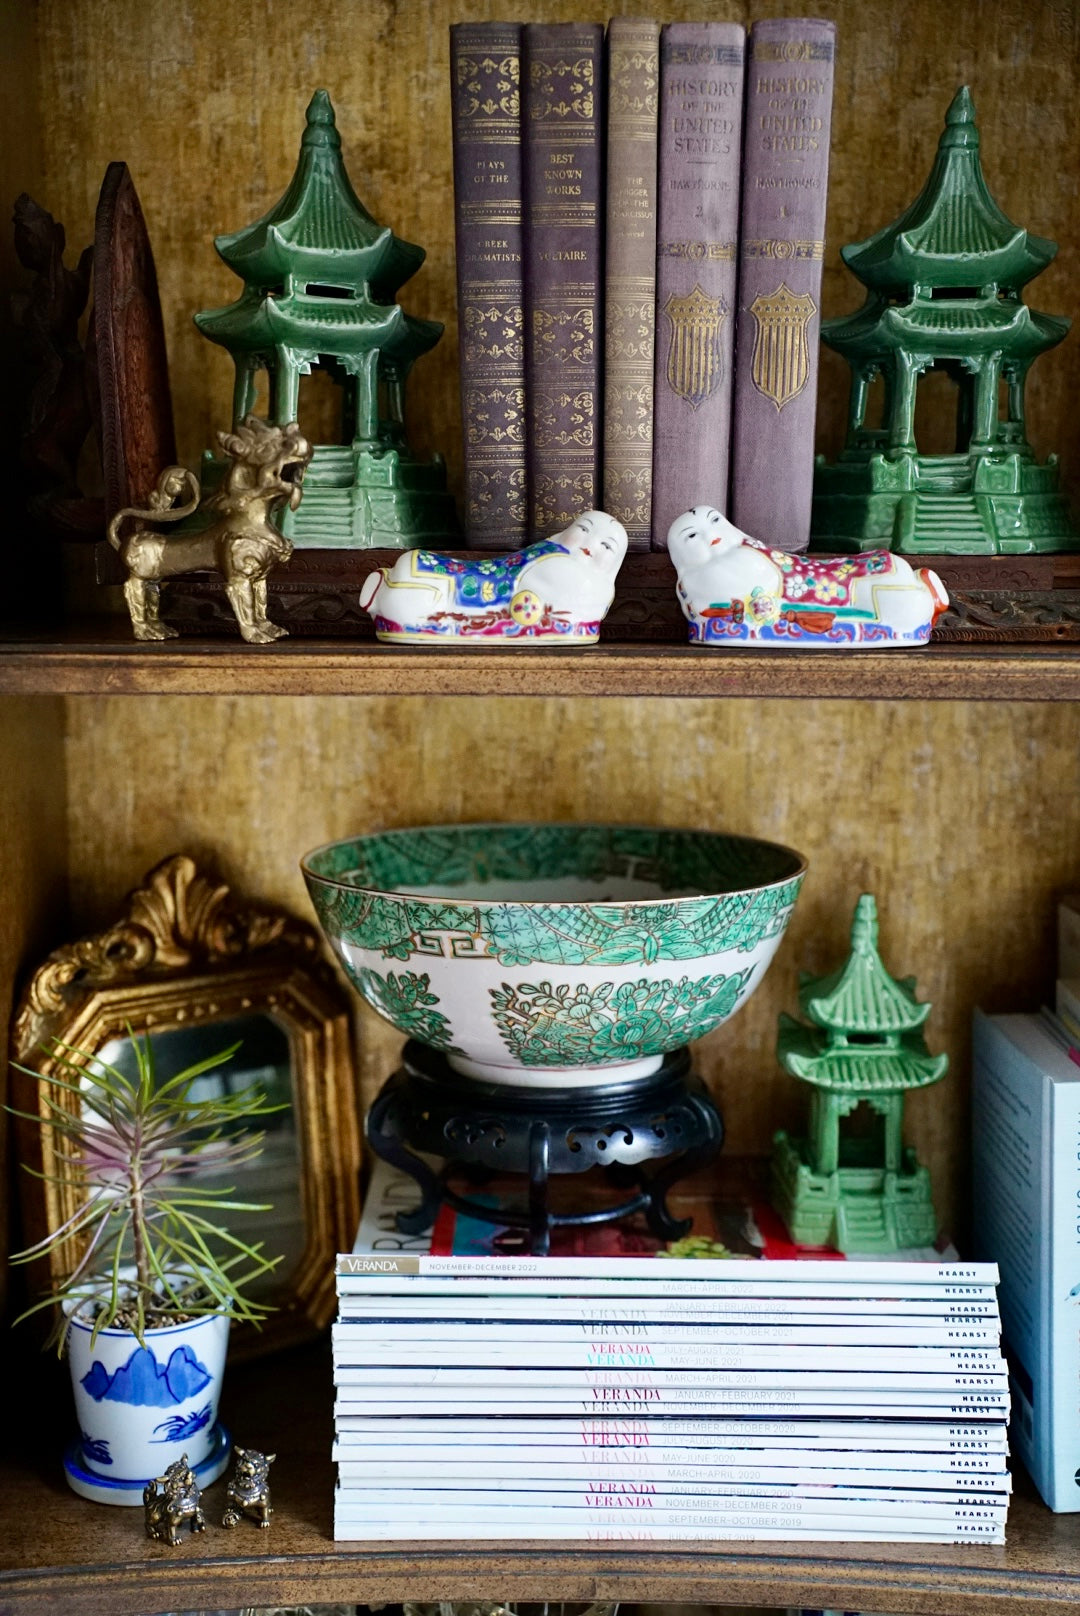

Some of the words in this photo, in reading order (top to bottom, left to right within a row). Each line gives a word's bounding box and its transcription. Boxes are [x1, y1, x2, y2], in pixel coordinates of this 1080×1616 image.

[670, 79, 737, 97] HISTORY
[756, 78, 827, 95] HISTORY
[682, 101, 698, 112] OF
[703, 101, 725, 112] THE
[768, 98, 786, 110] OF
[673, 118, 733, 134] UNITED
[760, 116, 822, 132] UNITED
[674, 138, 730, 154] STATES
[760, 136, 819, 152] STATES
[550, 154, 575, 164] BEST
[489, 175, 509, 183] THE
[544, 169, 582, 179] KNOWN
[546, 185, 581, 195] WORKS
[669, 179, 731, 191] HAWTHORNE
[634, 200, 649, 208] THE
[695, 205, 703, 218] 2
[347, 1259, 398, 1272] VERANDA
[582, 1325, 649, 1336] VERANDA
[591, 1344, 651, 1354] VERANDA
[587, 1354, 655, 1365] VERANDA
[584, 1372, 653, 1384] VERANDA
[592, 1388, 661, 1400] VERANDA
[581, 1402, 650, 1412] VERANDA
[581, 1420, 649, 1432] VERANDA
[582, 1434, 650, 1445] VERANDA
[582, 1451, 649, 1463] VERANDA
[589, 1482, 657, 1492] VERANDA
[585, 1495, 653, 1507] VERANDA
[780, 1502, 802, 1511] 2019
[779, 1517, 802, 1526] 2019
